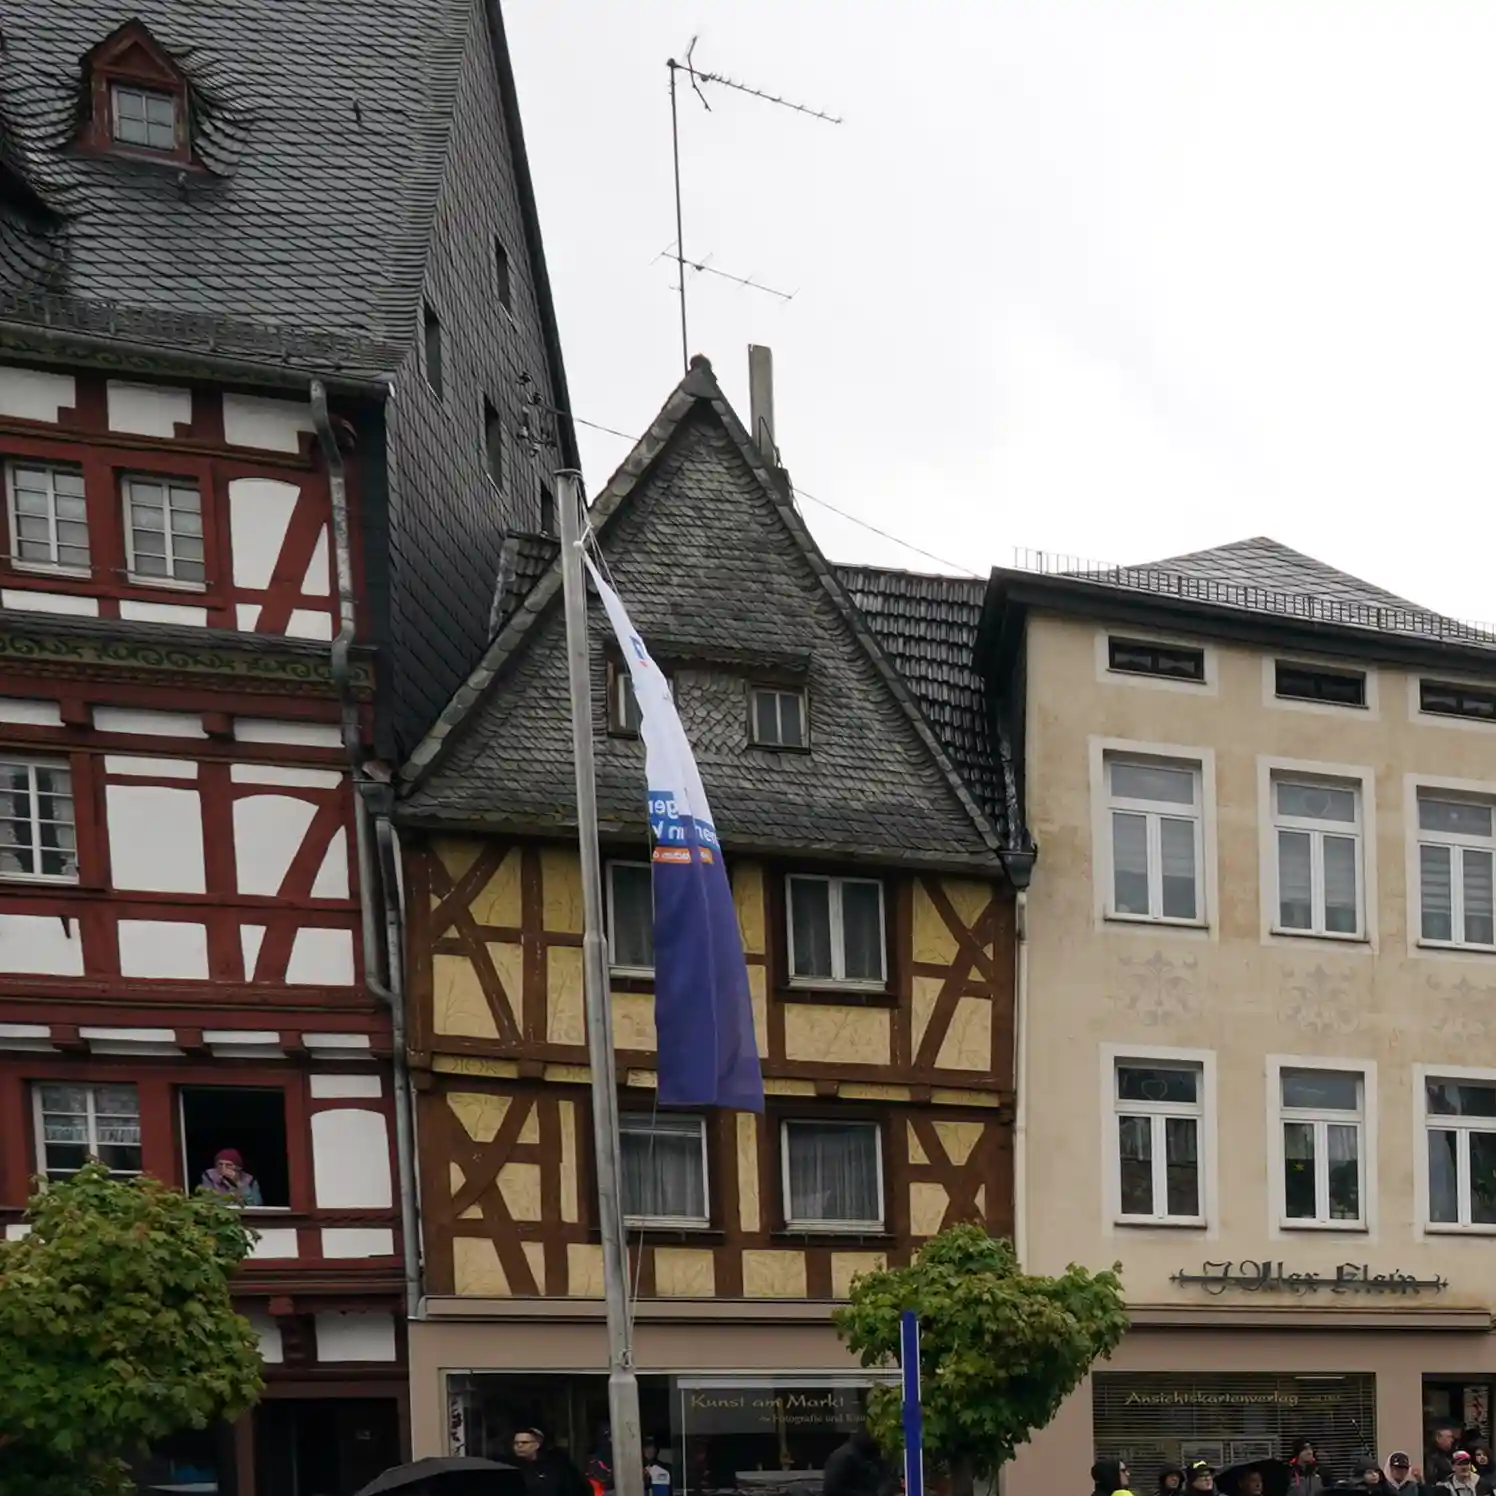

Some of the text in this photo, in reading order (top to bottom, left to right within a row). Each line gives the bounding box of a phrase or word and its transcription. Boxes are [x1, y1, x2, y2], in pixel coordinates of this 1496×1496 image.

[691, 1391, 846, 1410] Kunst am Markt
